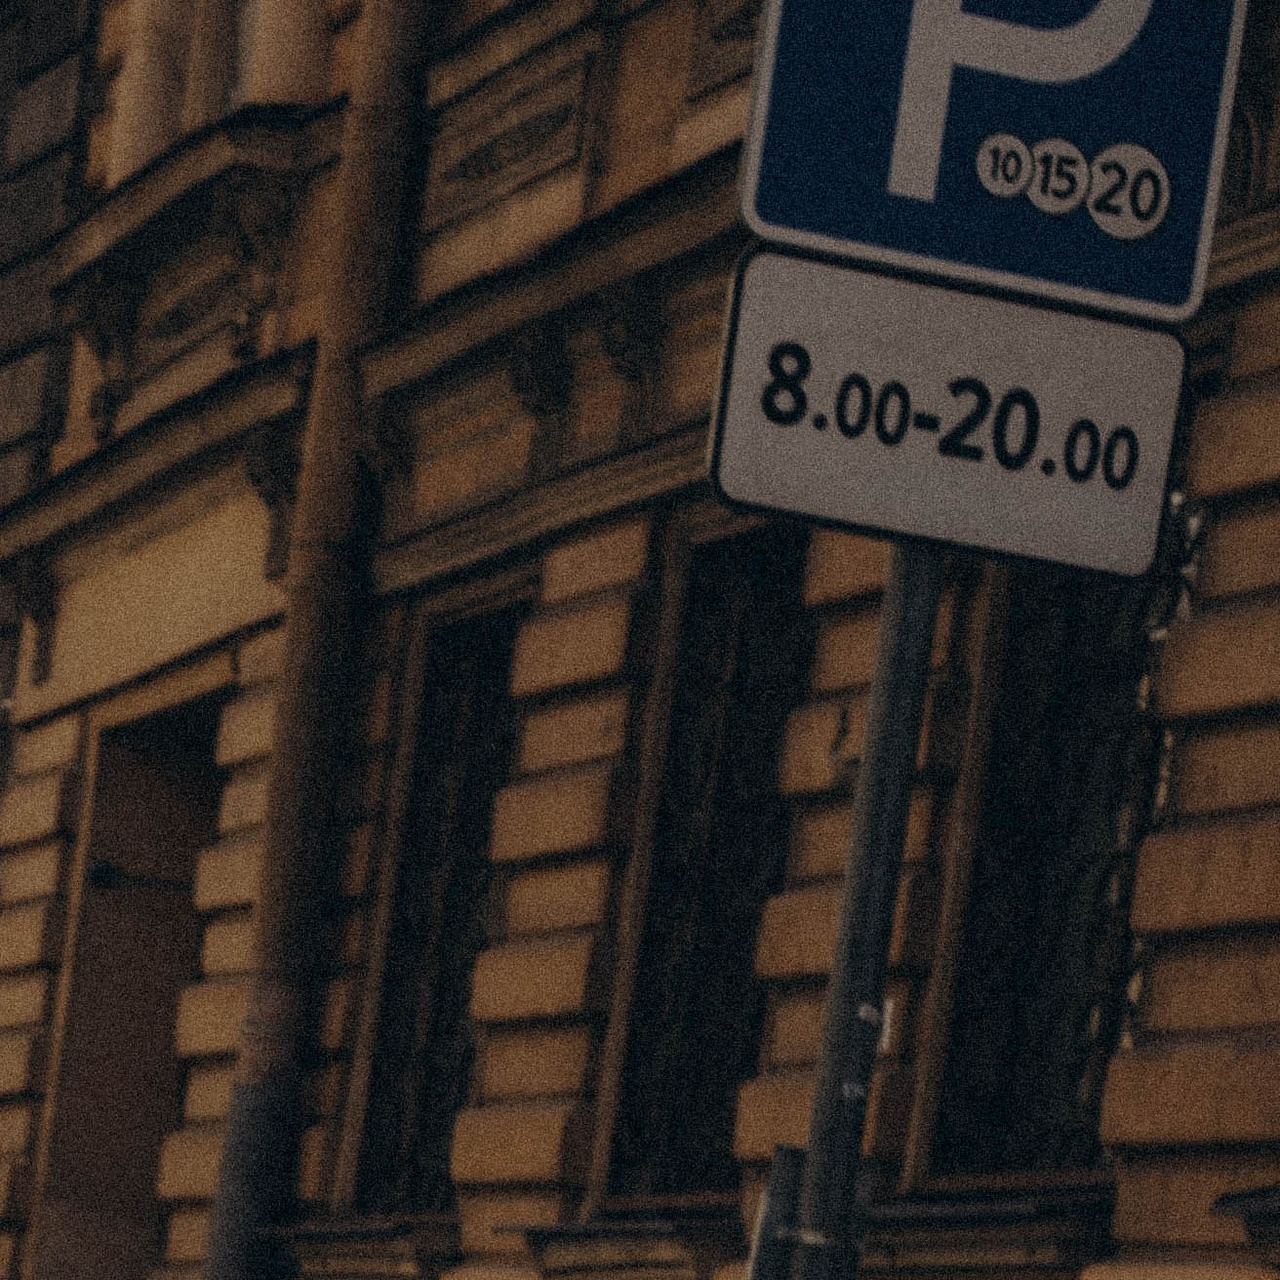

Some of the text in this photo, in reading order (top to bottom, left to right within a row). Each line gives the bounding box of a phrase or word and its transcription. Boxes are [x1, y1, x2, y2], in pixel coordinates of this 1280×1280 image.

[887, 0, 1154, 203] P
[988, 147, 1163, 221] 10 15 20
[761, 341, 1140, 491] 8.00-20.00
